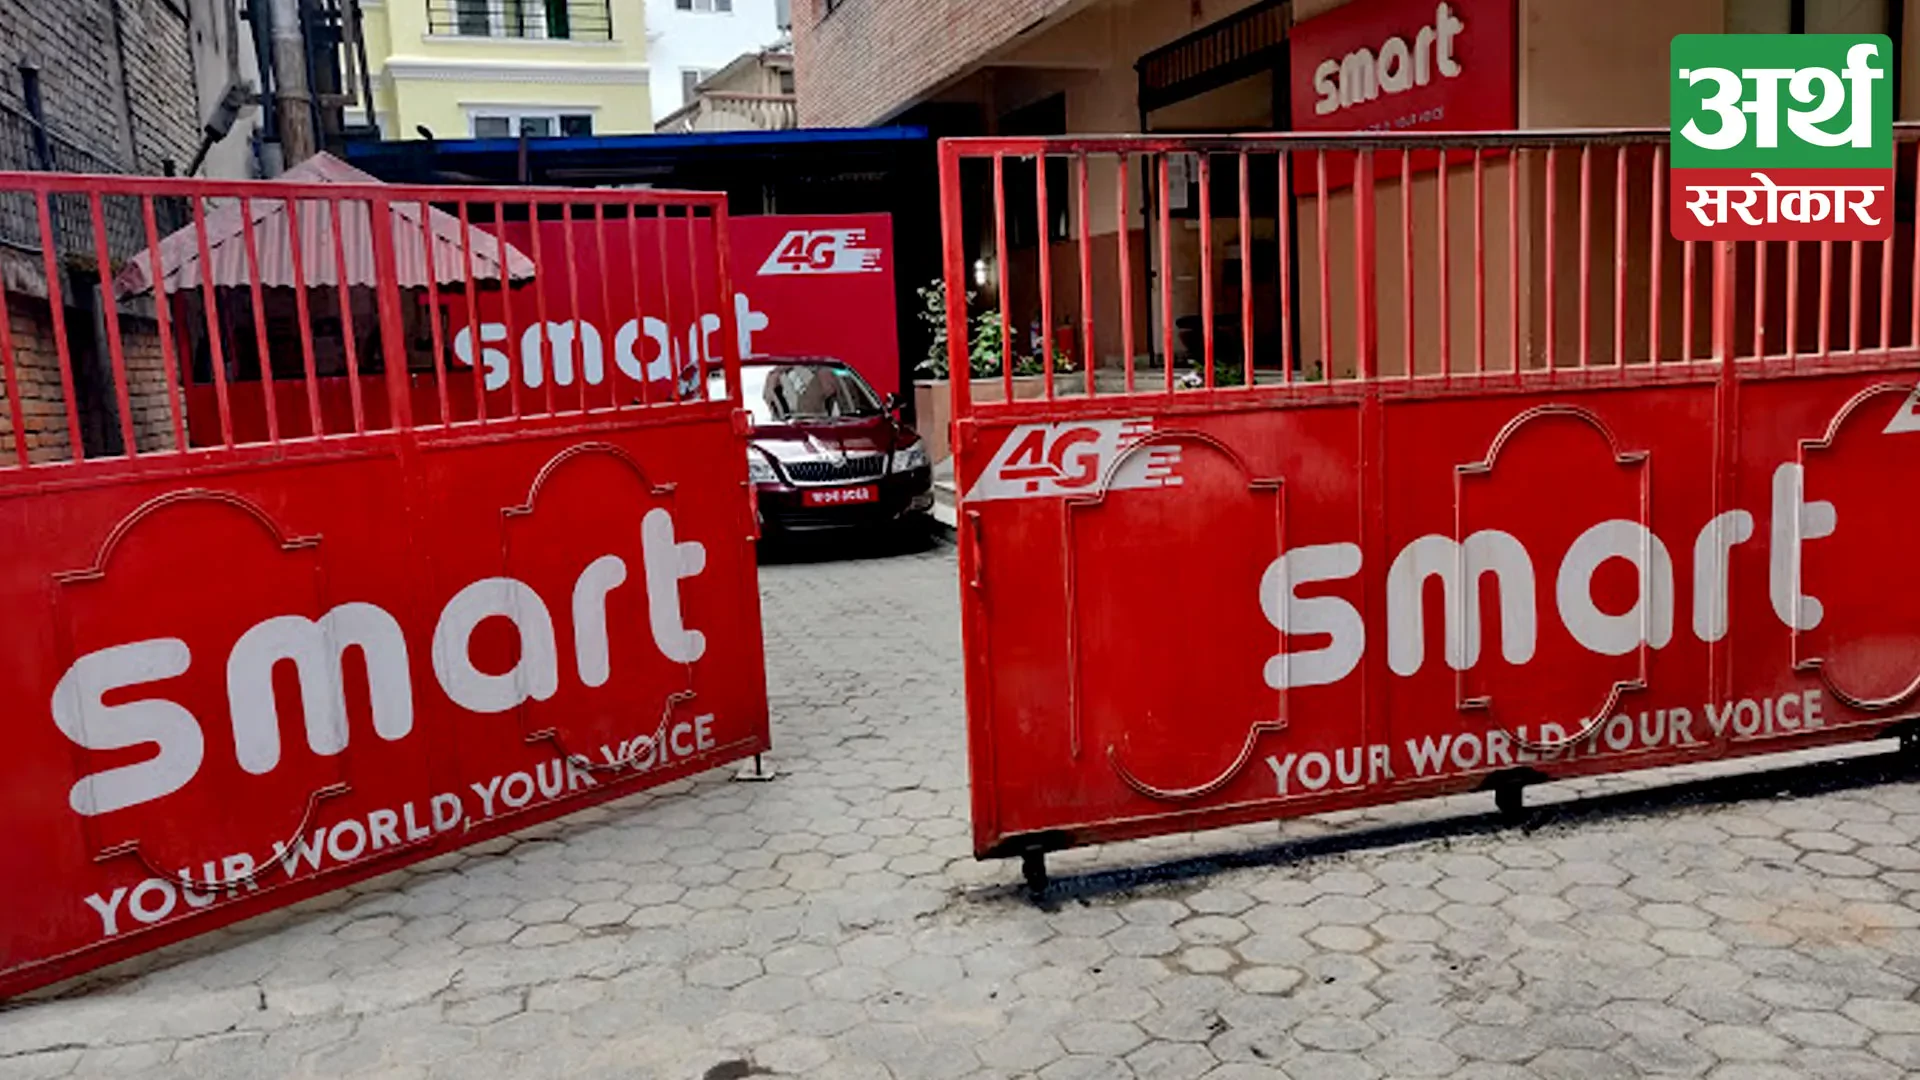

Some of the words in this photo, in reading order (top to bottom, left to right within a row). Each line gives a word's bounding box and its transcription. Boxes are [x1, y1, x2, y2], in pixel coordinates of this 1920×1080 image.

[1314, 1, 1464, 115] smart
[454, 292, 769, 391] smart
[999, 426, 1103, 493] 4G
[1259, 461, 1838, 690] smart
[50, 507, 707, 818] smart
[1265, 744, 1396, 796] YOUR
[1579, 707, 1695, 756] YOUR
[1704, 689, 1825, 737] VOICE
[84, 852, 258, 937] YOUR
[470, 753, 599, 818] YOUR
[600, 712, 717, 772] VOICE
